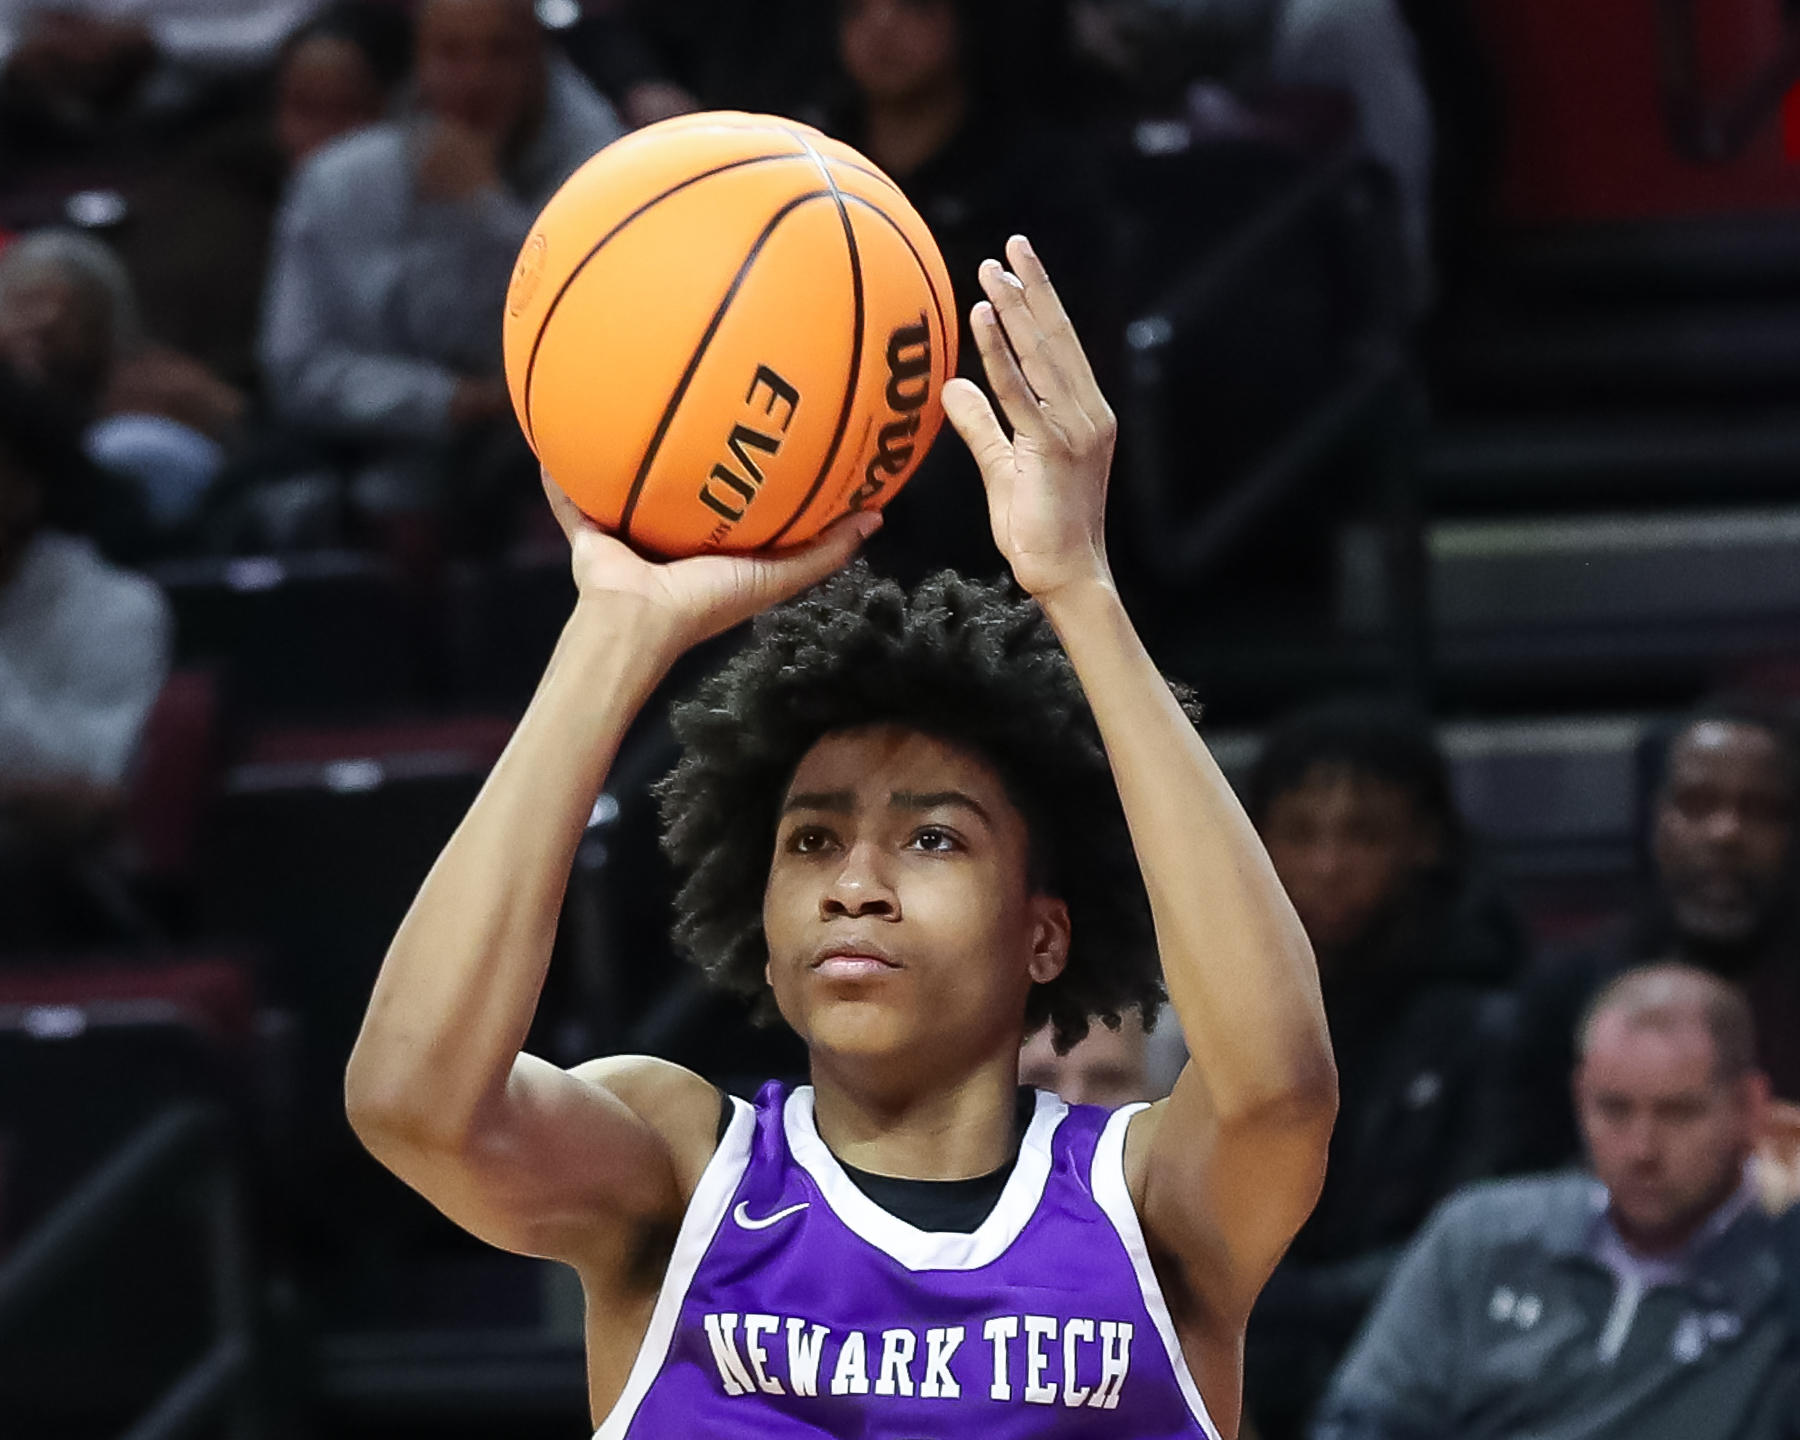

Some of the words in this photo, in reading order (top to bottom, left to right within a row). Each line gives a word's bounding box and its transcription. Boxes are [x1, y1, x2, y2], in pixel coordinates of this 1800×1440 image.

[698, 363, 801, 523] EVO
[848, 307, 932, 514] Wils
[703, 1312, 966, 1399] NEWARK
[983, 1314, 1135, 1410] TECH
